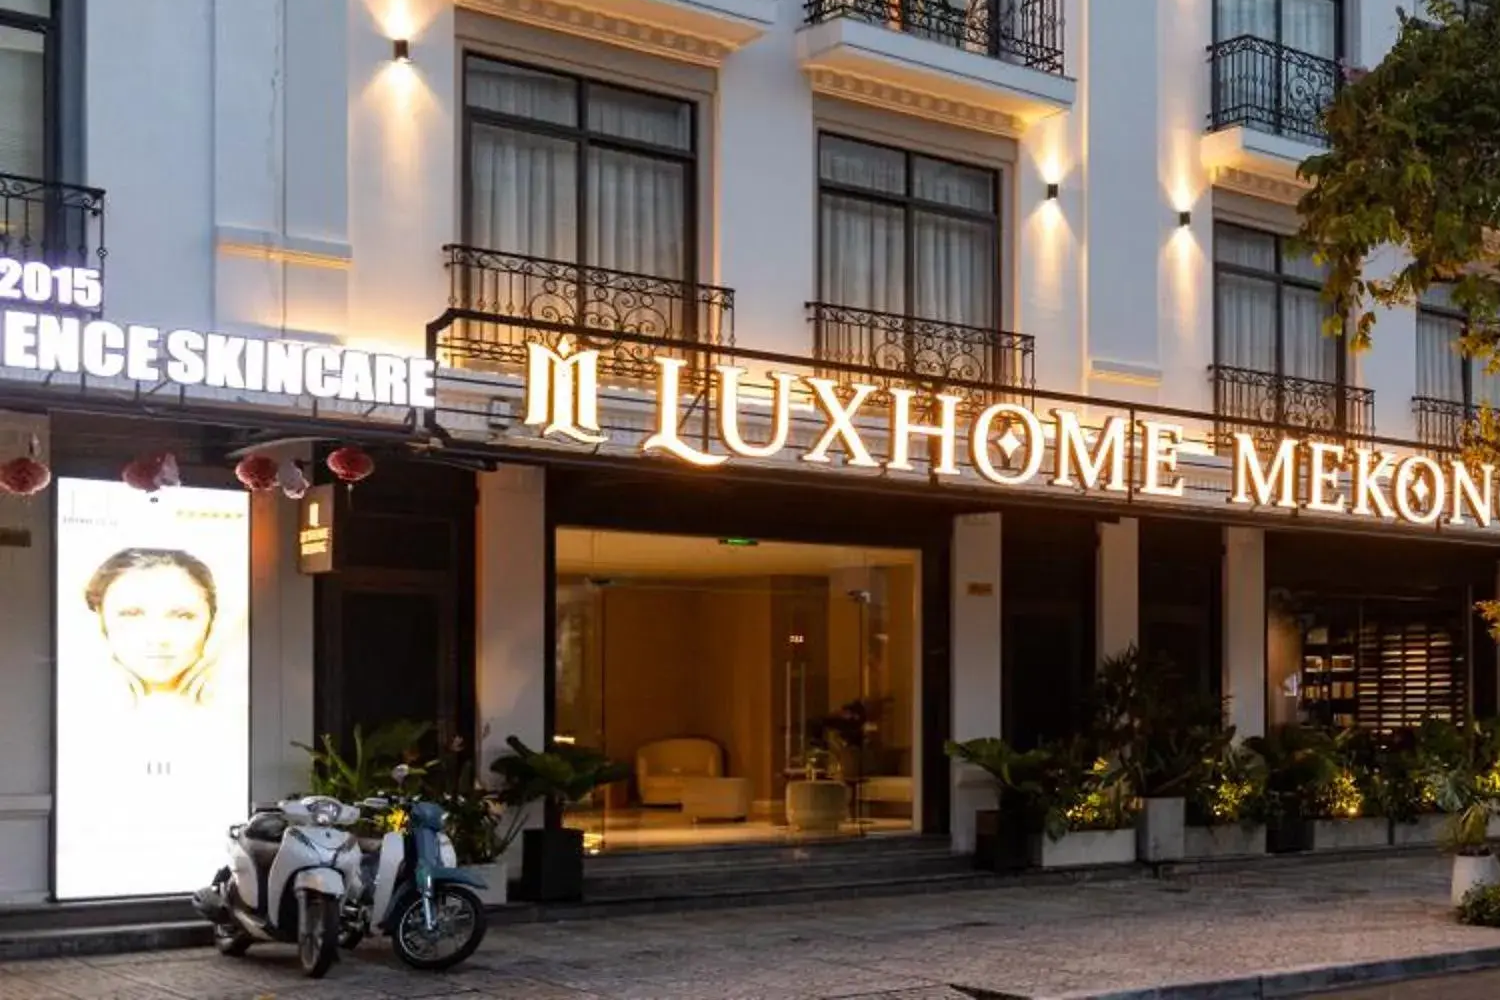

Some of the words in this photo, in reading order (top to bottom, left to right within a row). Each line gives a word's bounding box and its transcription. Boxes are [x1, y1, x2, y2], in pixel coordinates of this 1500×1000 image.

[0, 256, 103, 308] 2015
[4, 309, 160, 382] ENCE
[166, 329, 435, 409] SKINCARE
[643, 355, 1184, 497] LUXHOME
